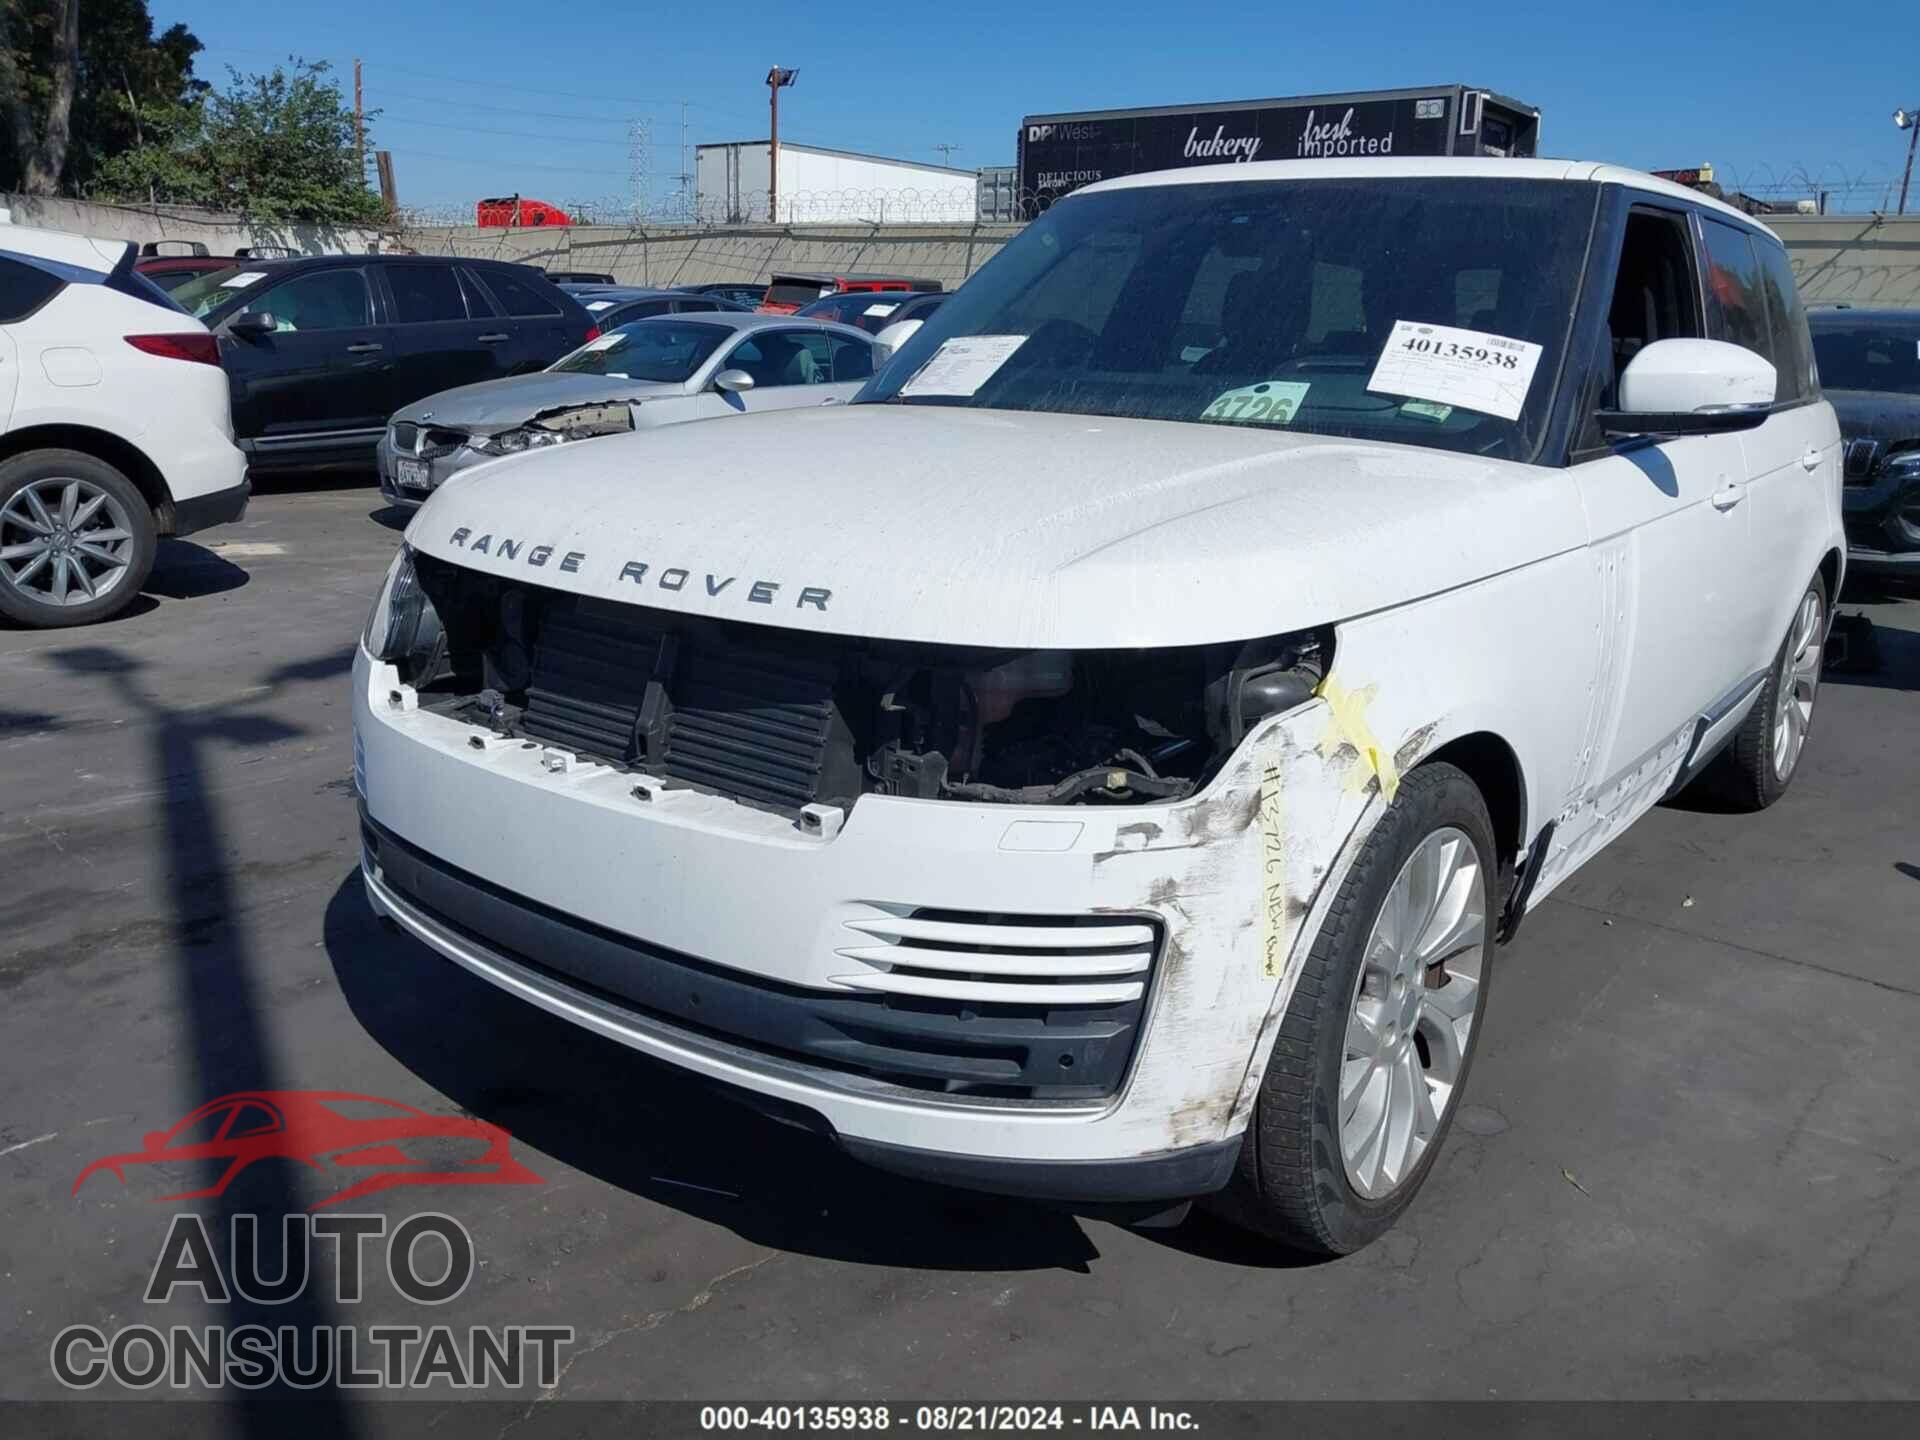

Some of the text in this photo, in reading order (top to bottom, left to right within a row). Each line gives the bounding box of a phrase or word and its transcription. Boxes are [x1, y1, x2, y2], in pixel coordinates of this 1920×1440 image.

[1302, 107, 1355, 141] fresh
[1184, 125, 1263, 163] bakery
[1297, 132, 1393, 158] imported
[1401, 337, 1519, 370] 40135938
[449, 527, 832, 611] RANGE ROVER
